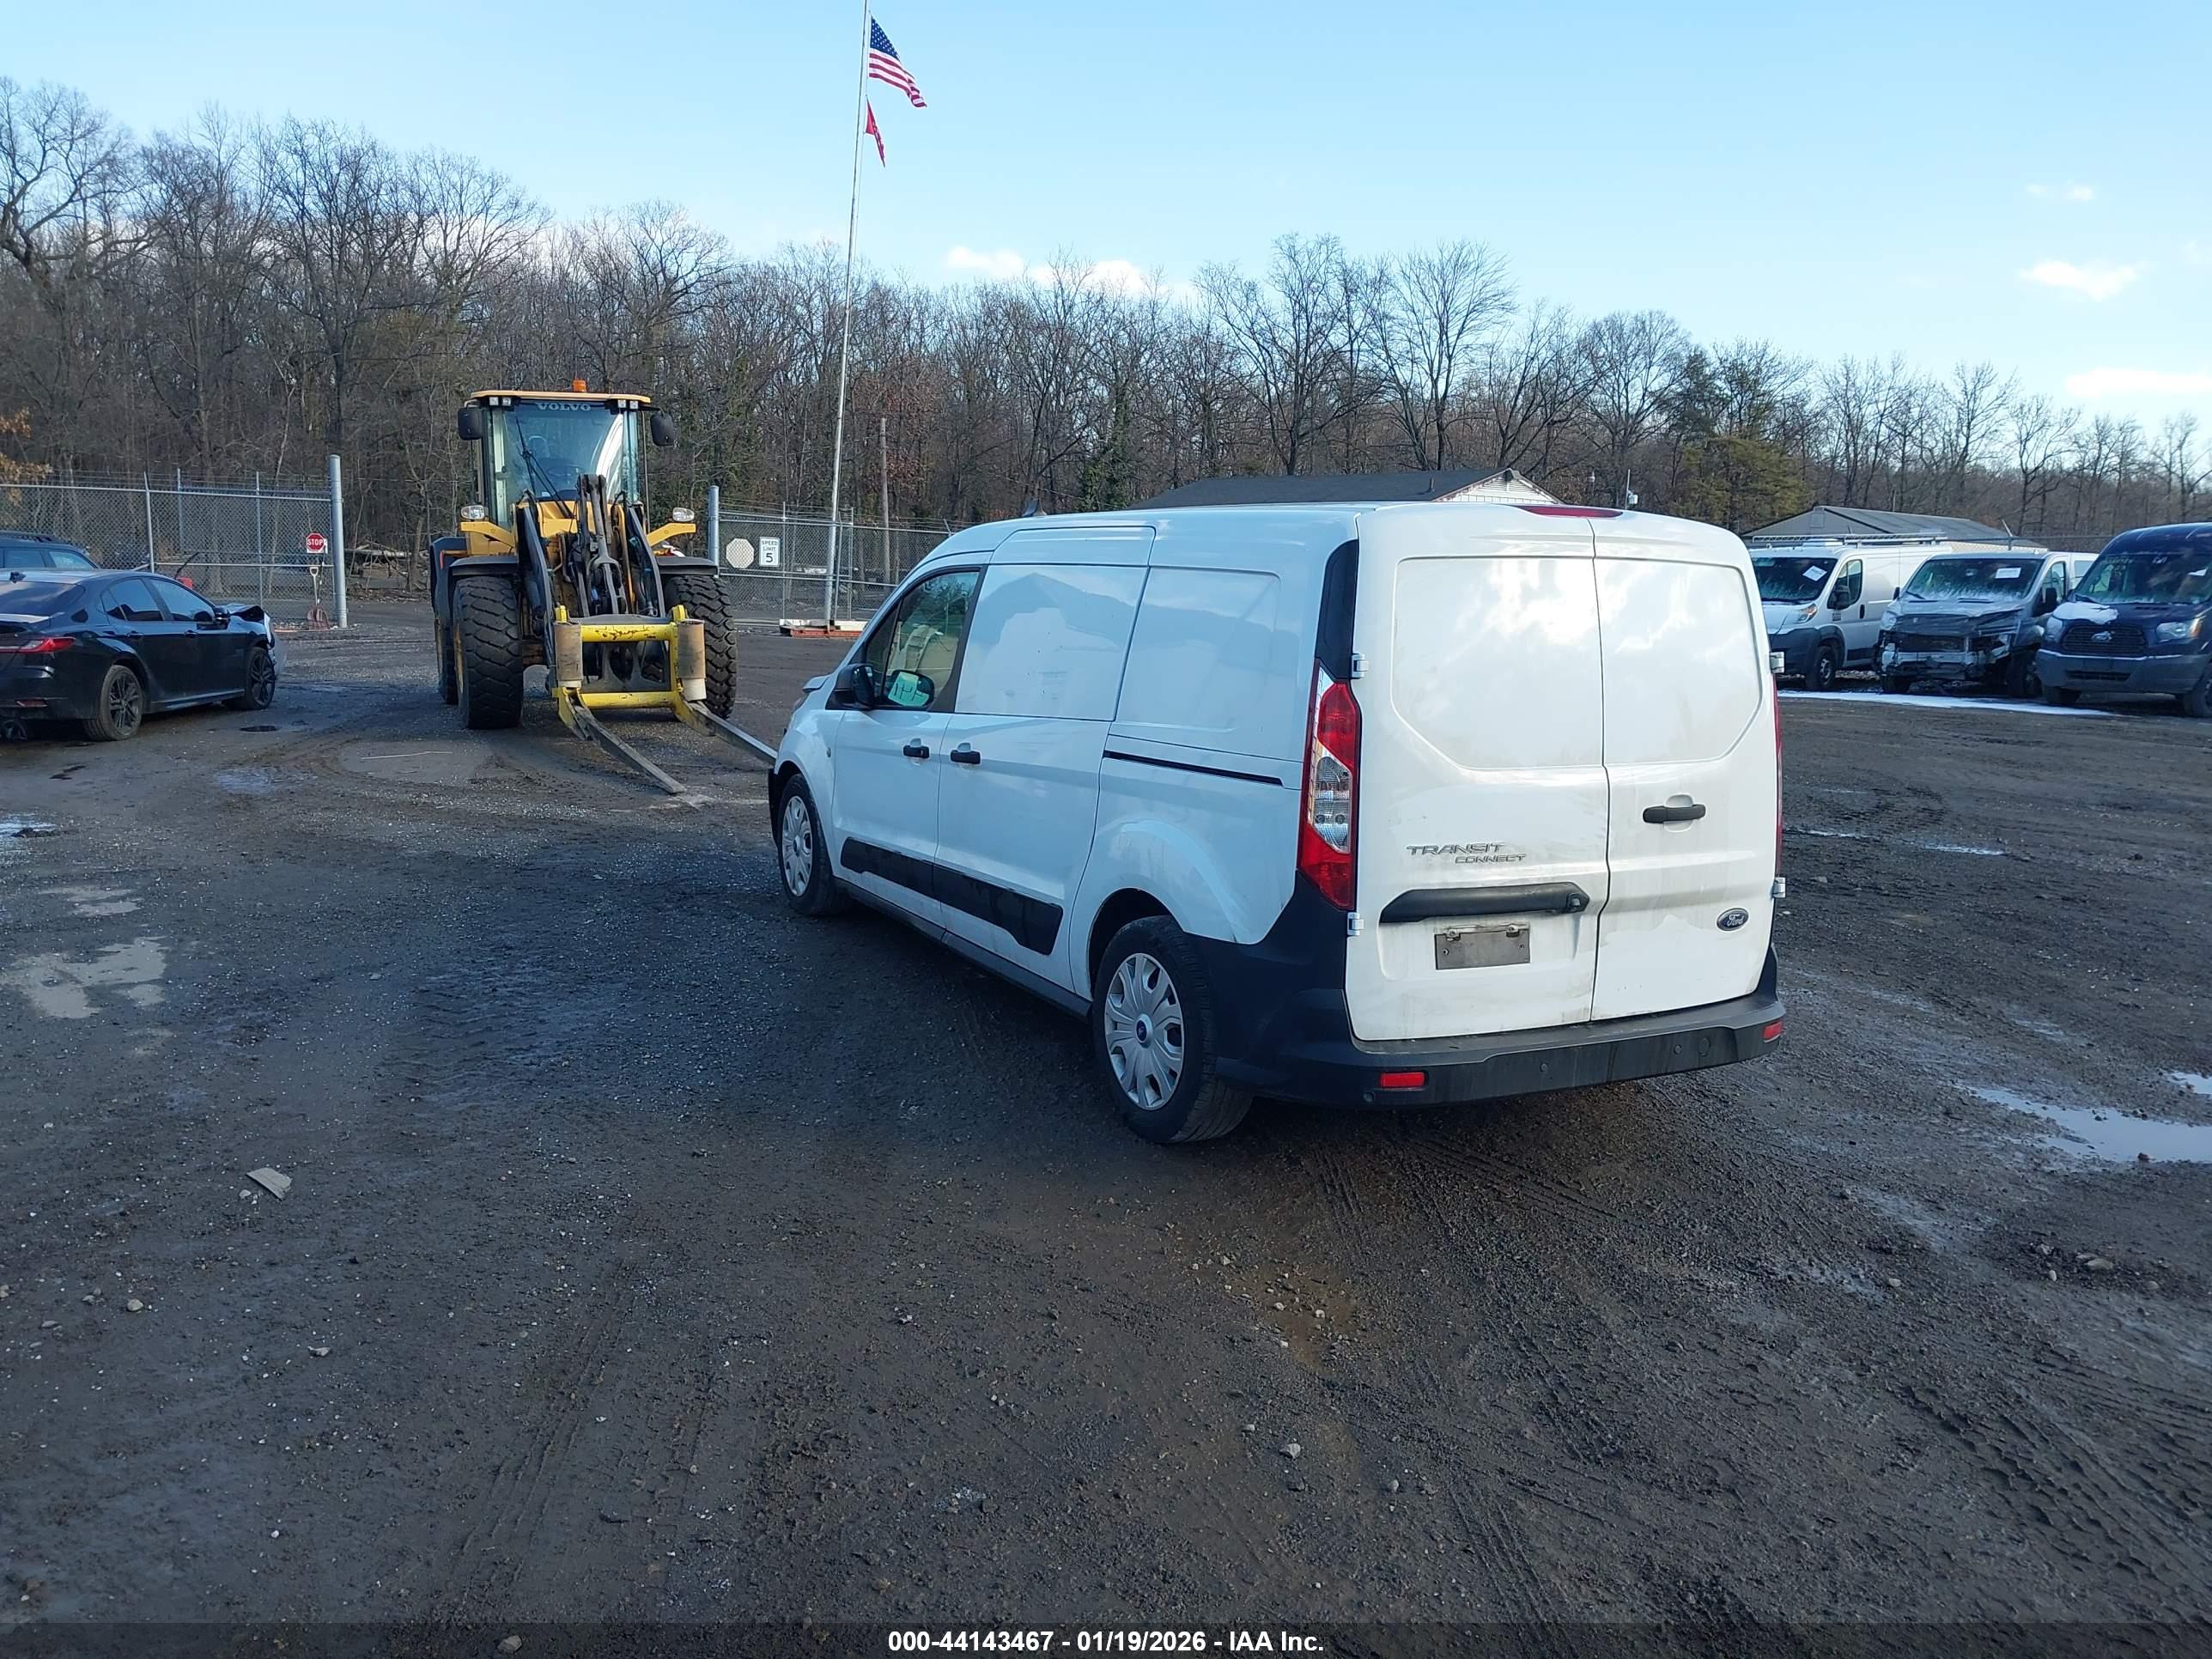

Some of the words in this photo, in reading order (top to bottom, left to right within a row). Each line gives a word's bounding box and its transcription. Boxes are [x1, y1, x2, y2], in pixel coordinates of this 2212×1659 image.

[535, 402, 592, 411] VOLVO
[765, 552, 774, 563] 5
[1407, 842, 1504, 856] TRANSIT
[1455, 854, 1526, 864] CONNECT
